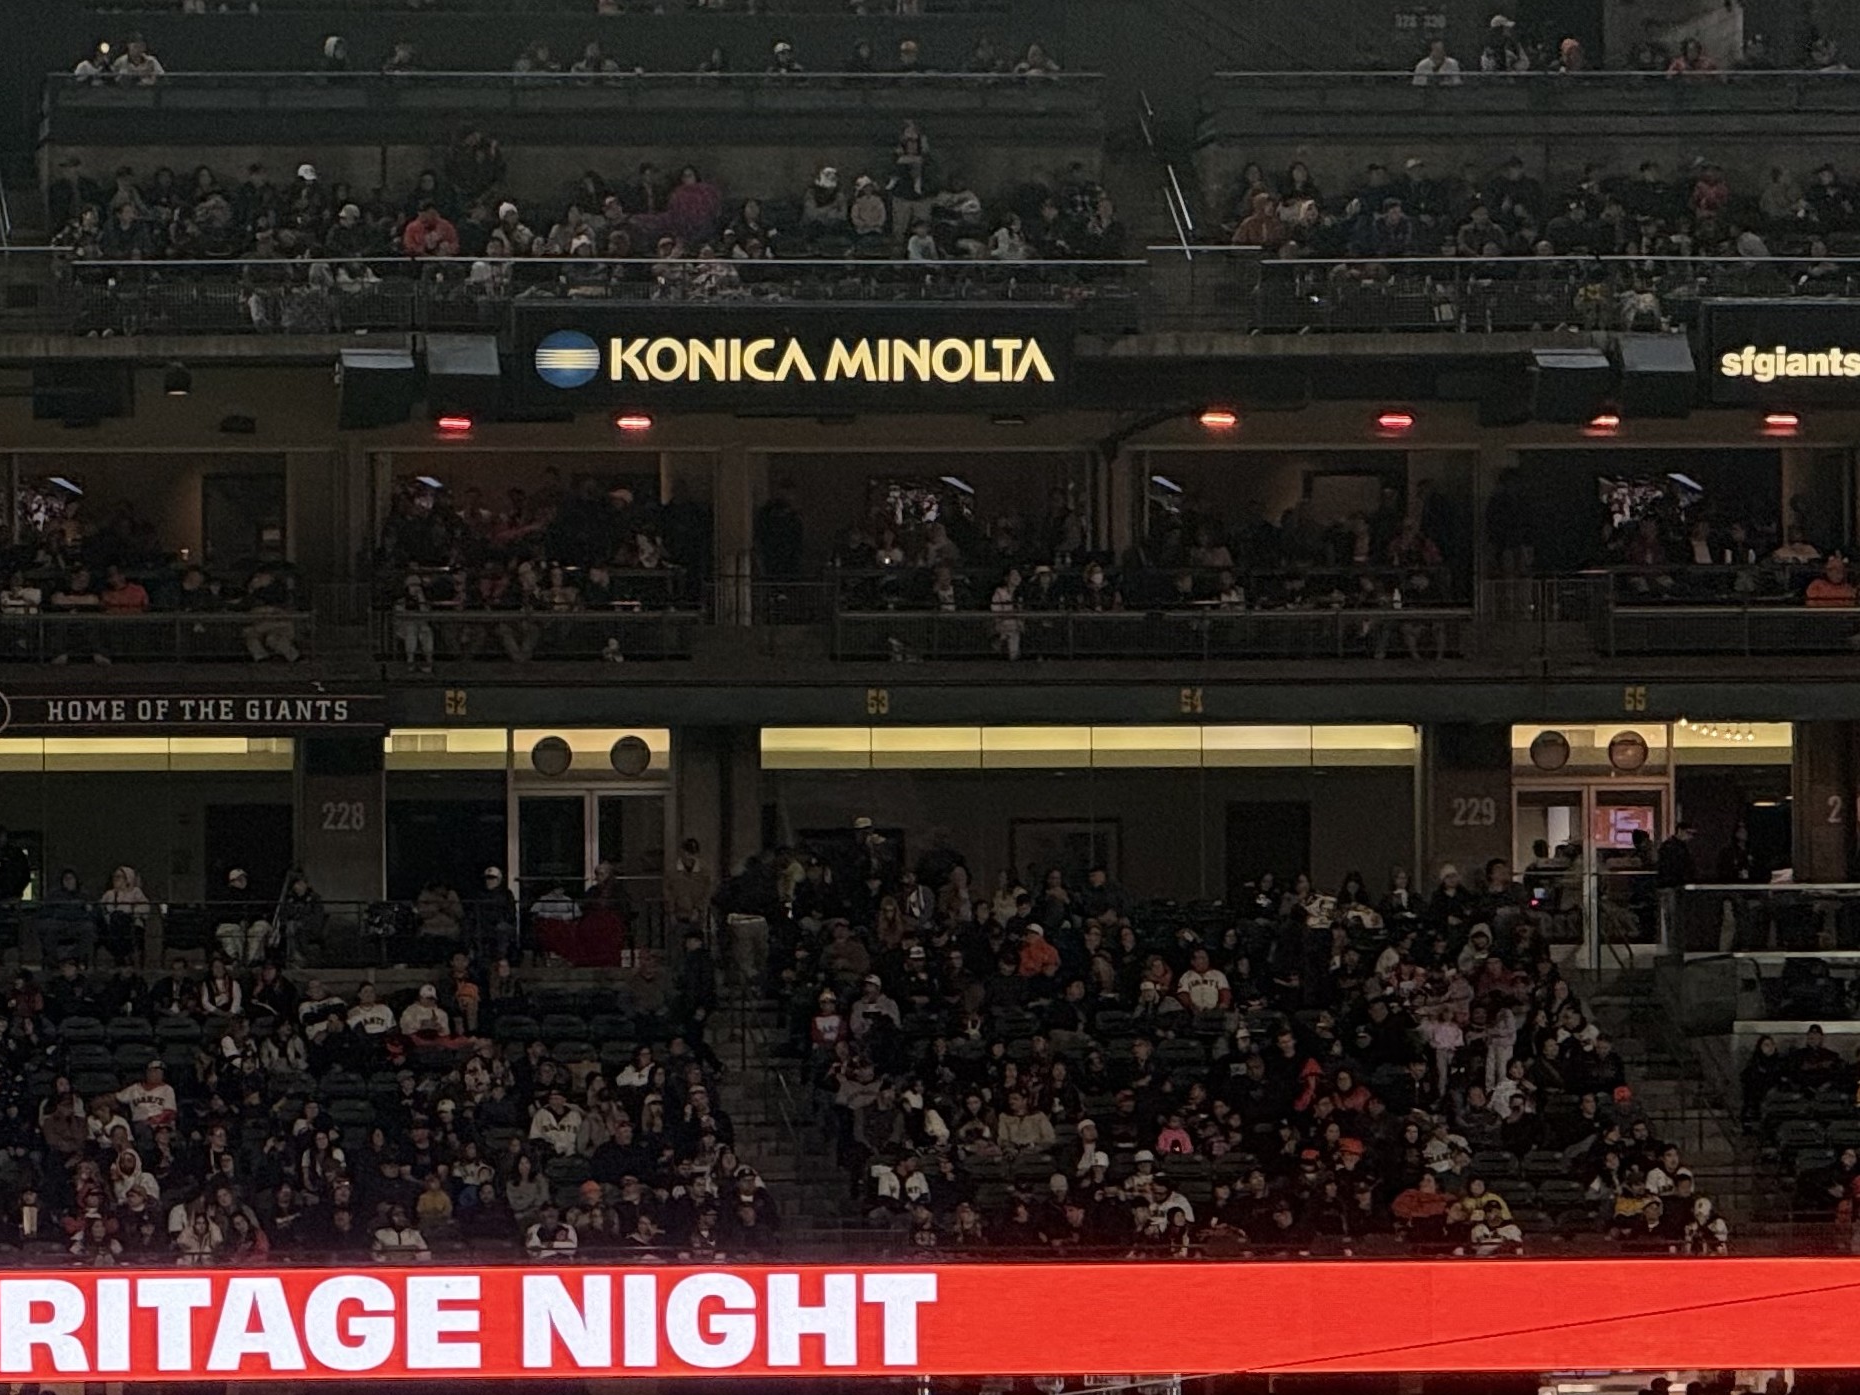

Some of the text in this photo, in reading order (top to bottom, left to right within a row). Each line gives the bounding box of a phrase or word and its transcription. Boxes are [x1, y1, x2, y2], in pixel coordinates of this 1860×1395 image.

[610, 337, 1055, 382] KONICA MINOLTA
[1721, 345, 1860, 383] sfgiants
[48, 700, 348, 721] HOME OF THE GIANTS
[322, 802, 364, 830] 228
[1453, 797, 1495, 825] 229
[523, 1272, 937, 1370] NIGHT
